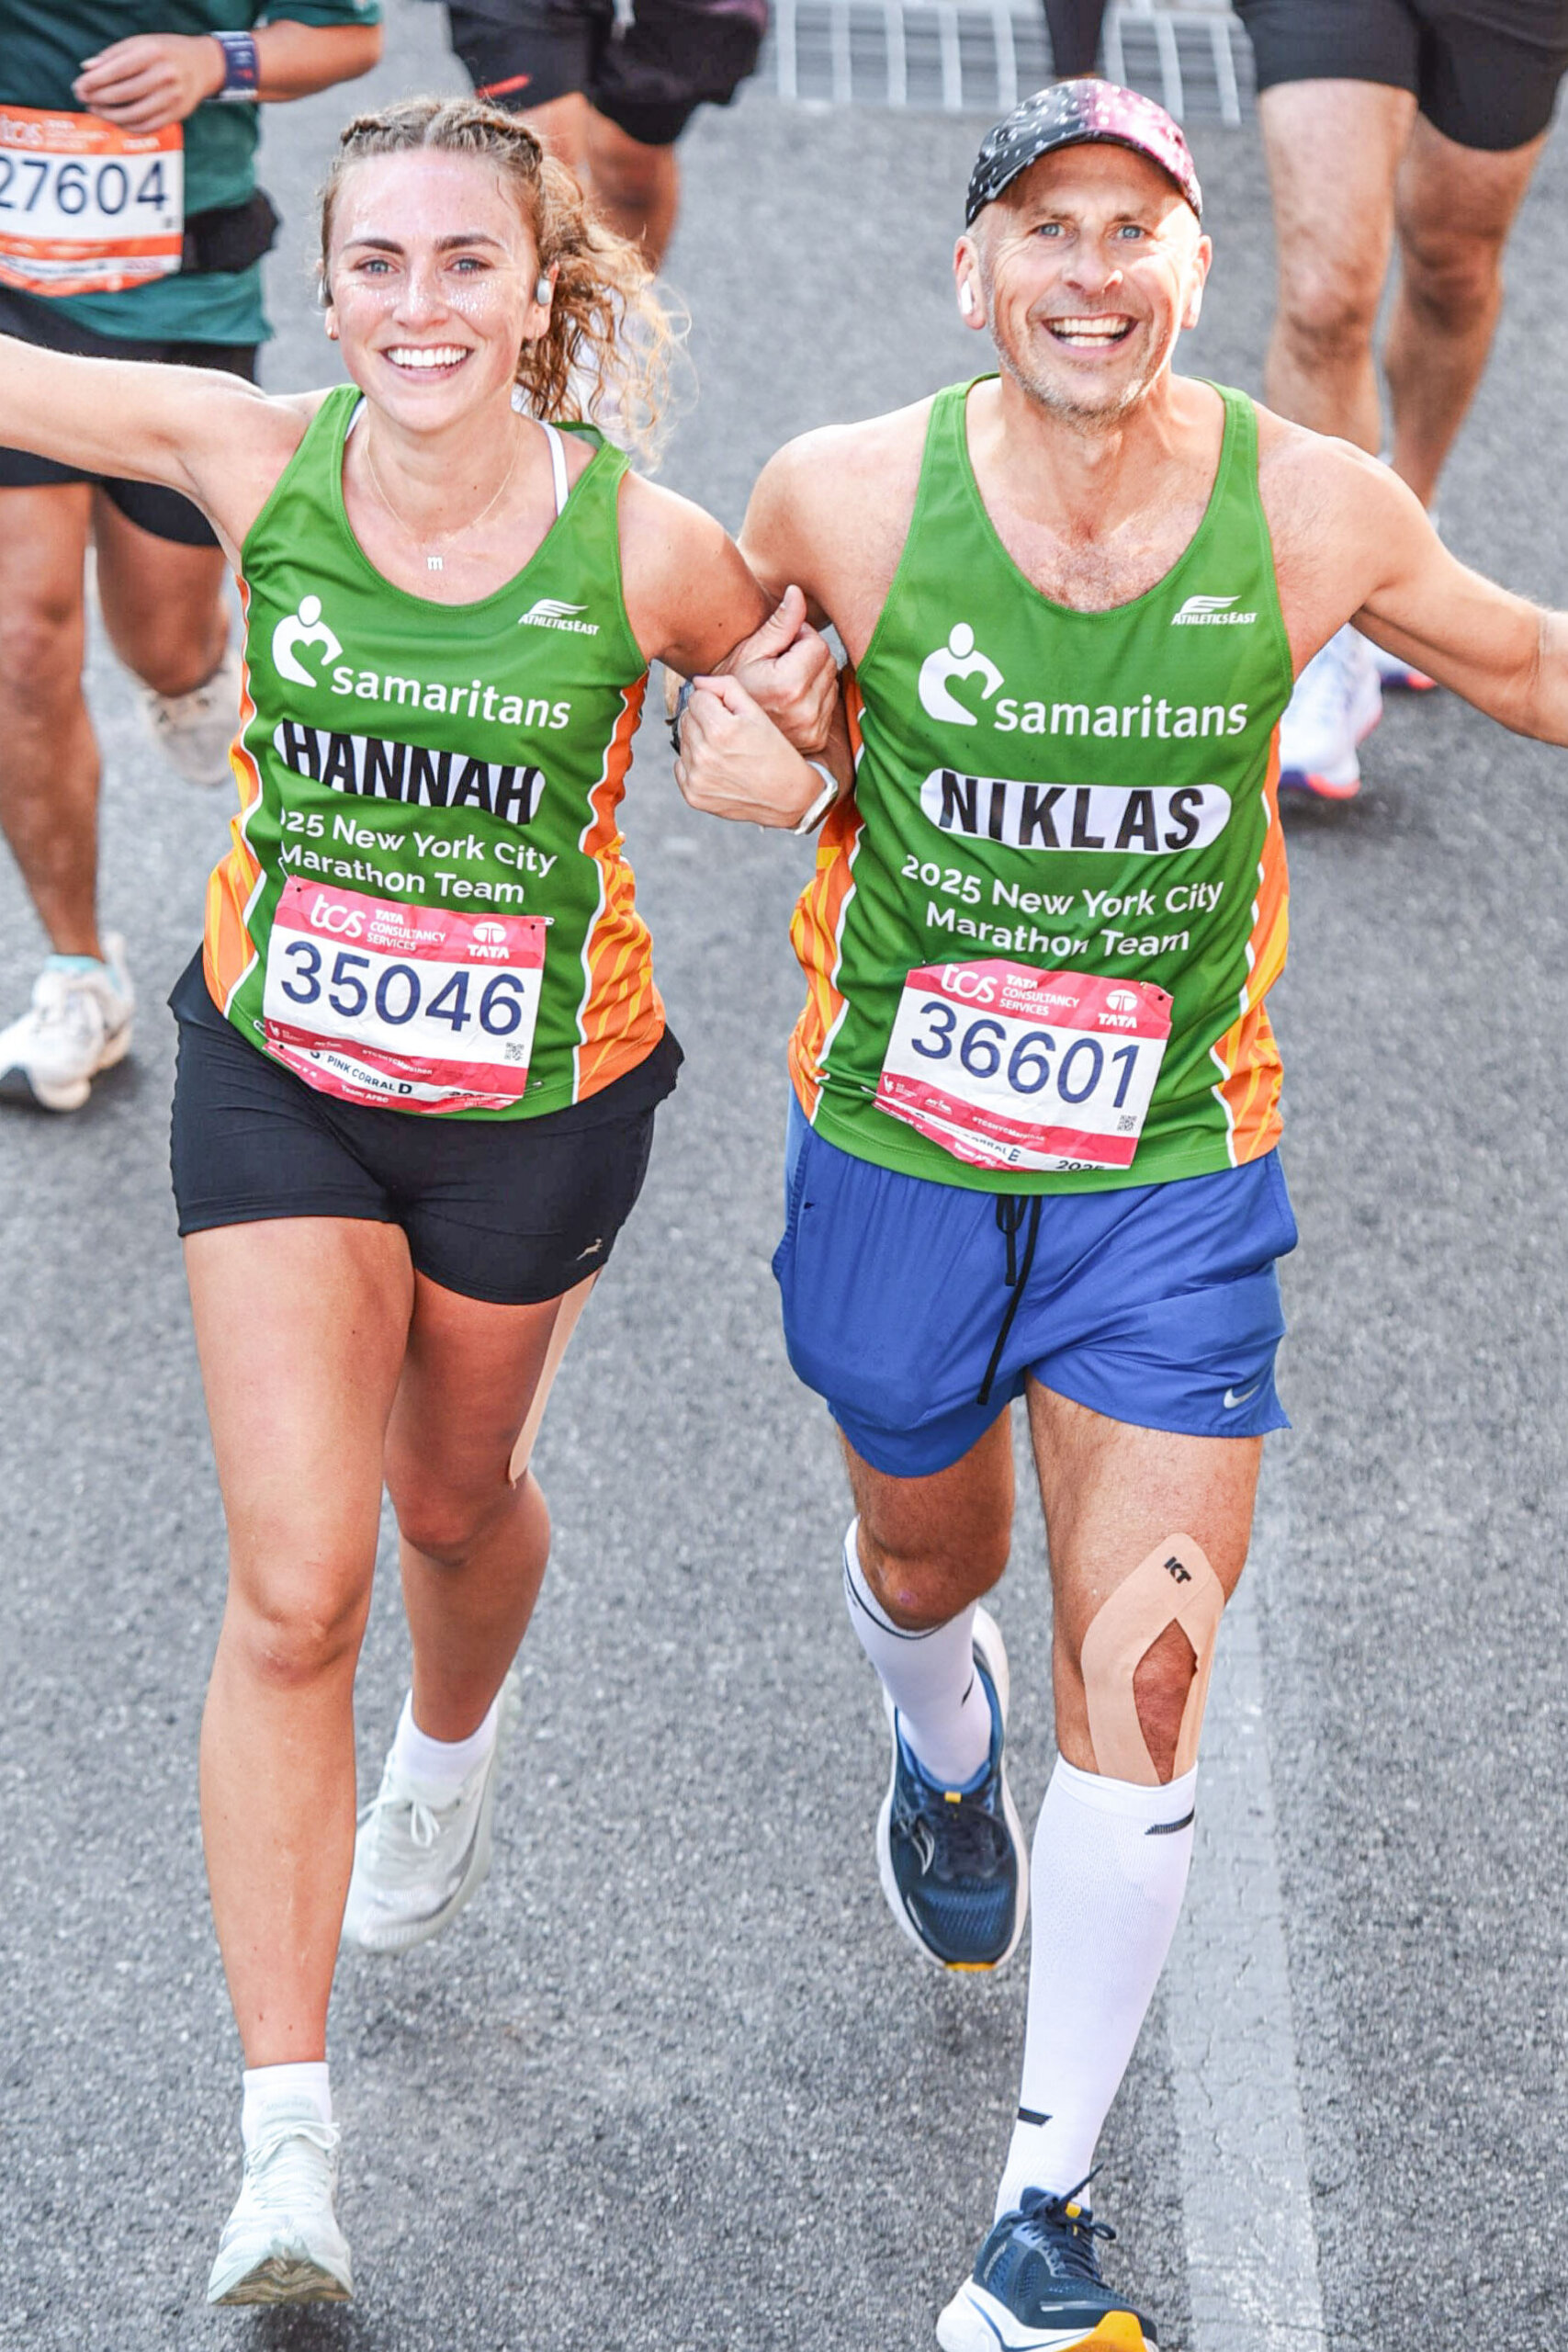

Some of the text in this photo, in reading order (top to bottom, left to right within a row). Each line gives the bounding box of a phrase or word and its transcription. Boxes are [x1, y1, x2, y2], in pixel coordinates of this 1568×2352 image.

[0, 157, 166, 215] 27604
[332, 666, 571, 729] samaritans
[994, 695, 1248, 739] samaritans
[282, 718, 540, 825] HANNAH
[939, 769, 1204, 852] NIKLAS
[333, 814, 405, 852] New
[412, 831, 485, 862] York
[495, 841, 558, 878] City
[280, 841, 525, 904] Marathon Team
[900, 854, 1224, 919] 2025 New York City
[310, 894, 366, 938] tcs
[370, 922, 446, 943] CONSULTANCY
[375, 909, 404, 925] TATA
[926, 902, 1190, 957] Marathon Team
[367, 933, 416, 951] SERVICES
[468, 944, 510, 959] TATA
[281, 941, 525, 1035] 35046
[941, 964, 998, 1003] tcs
[1002, 987, 1079, 1008] CONSULTANCY
[1006, 974, 1038, 989] TATA
[999, 998, 1049, 1016] SERVICES
[1098, 1012, 1138, 1028] TATA
[327, 1055, 351, 1073] PINK
[352, 1068, 395, 1091] CORRAL
[398, 1082, 412, 1094] D
[911, 1001, 1140, 1109] 36601
[1008, 1148, 1021, 1162] E
[1164, 1556, 1192, 1584] KT
